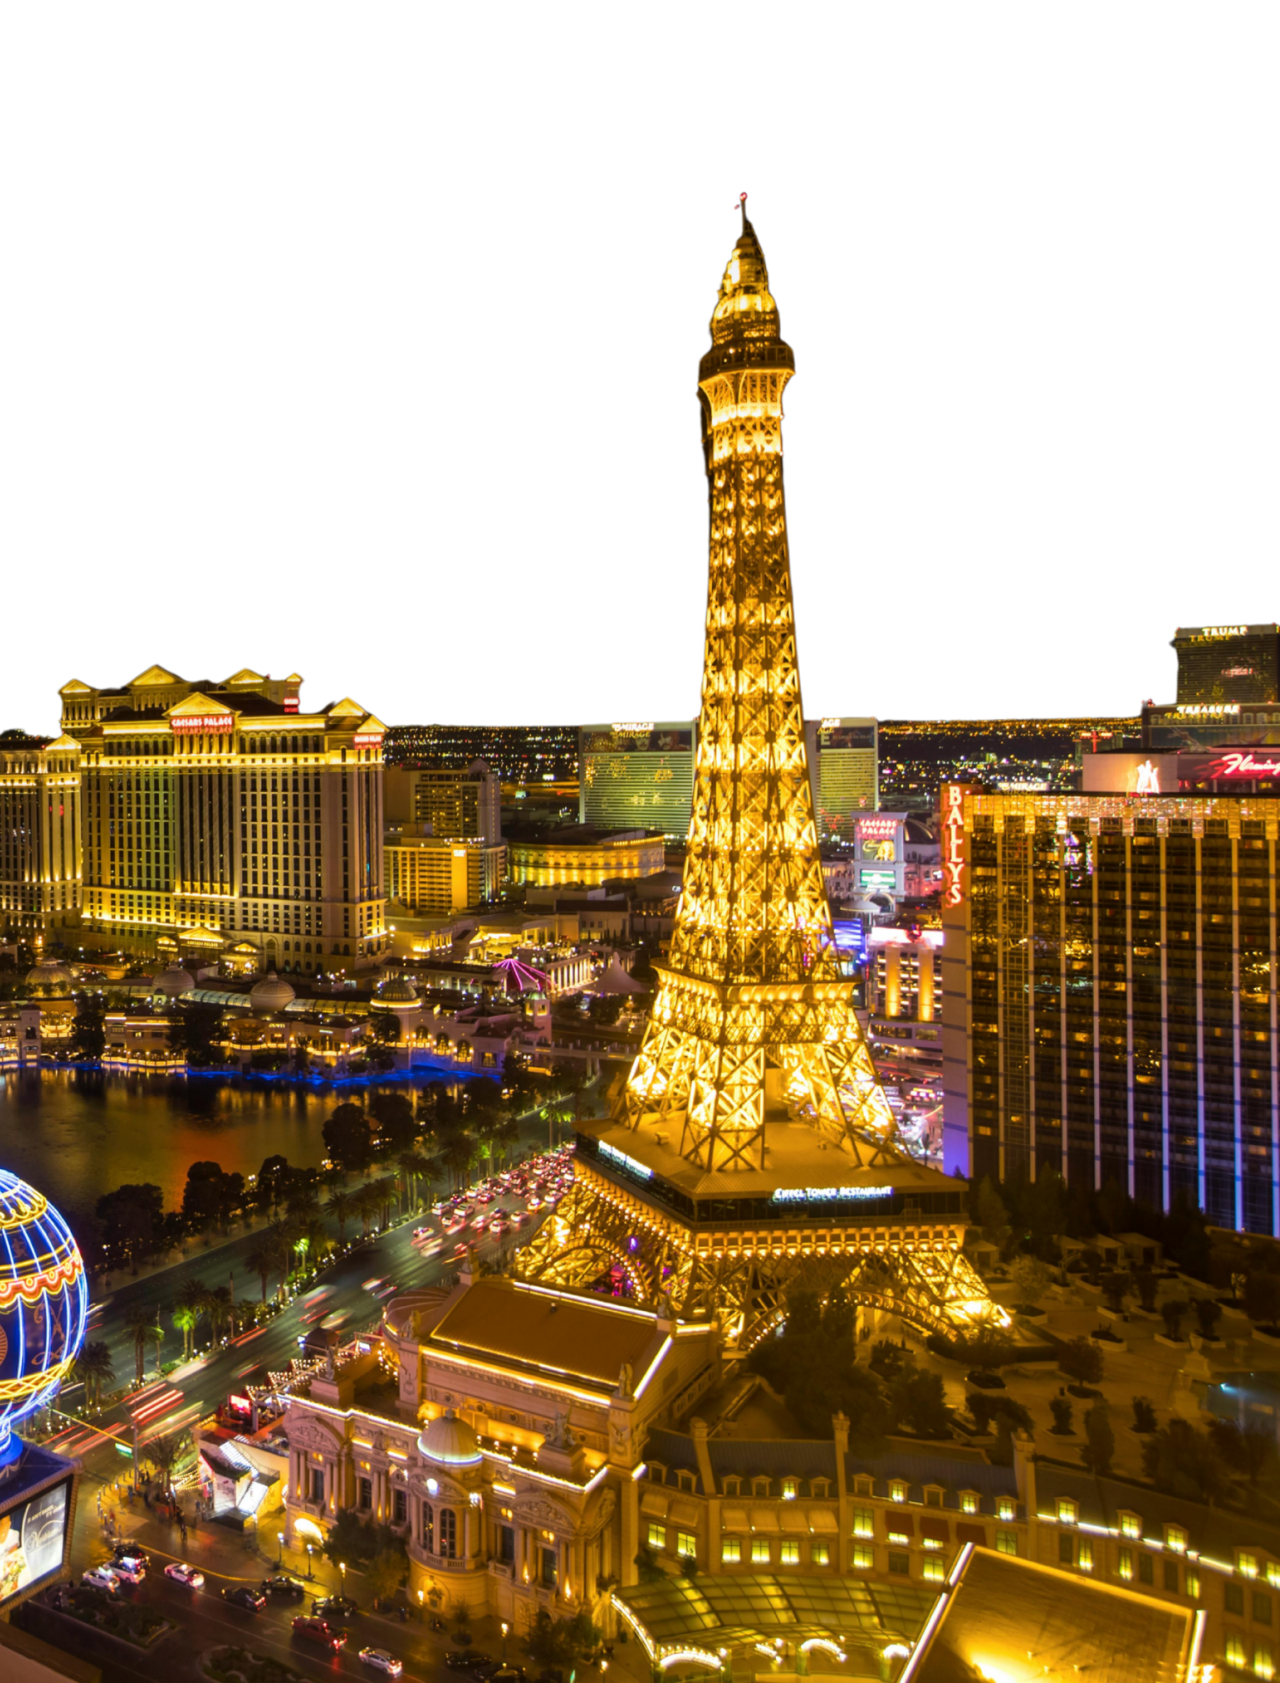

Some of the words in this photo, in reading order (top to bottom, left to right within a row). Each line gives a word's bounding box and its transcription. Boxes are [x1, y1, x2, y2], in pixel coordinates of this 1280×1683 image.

[1202, 625, 1248, 636] TRUMP
[1176, 704, 1241, 715] TREASURE
[171, 718, 202, 727] CAESARS
[204, 716, 233, 726] PALACE
[860, 819, 897, 827] CAESARS
[862, 827, 895, 835] PALACE
